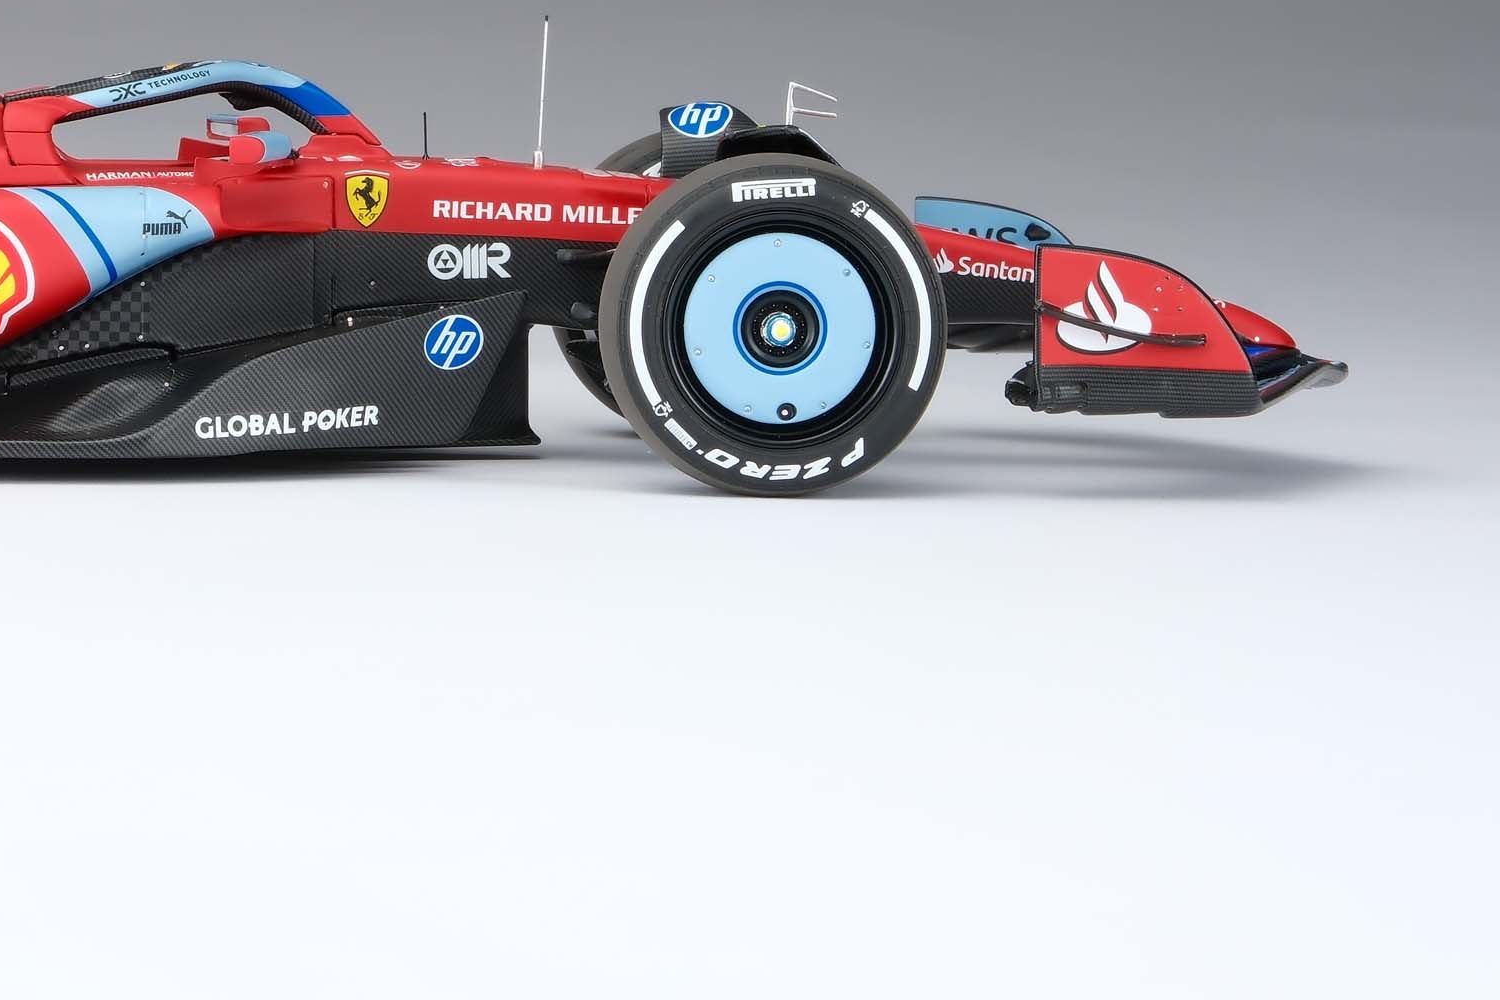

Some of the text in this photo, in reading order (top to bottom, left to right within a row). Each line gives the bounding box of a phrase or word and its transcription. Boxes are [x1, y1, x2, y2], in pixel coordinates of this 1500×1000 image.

[149, 70, 211, 89] TECHNOLOGY
[86, 171, 153, 181] HARMAN
[731, 178, 816, 202] PIRELLI
[432, 200, 643, 225] RICHARD MILLE
[143, 222, 182, 235] PUMA
[957, 256, 1035, 284] Santan
[195, 405, 379, 439] GLOBAL POKER
[840, 437, 866, 468] P
